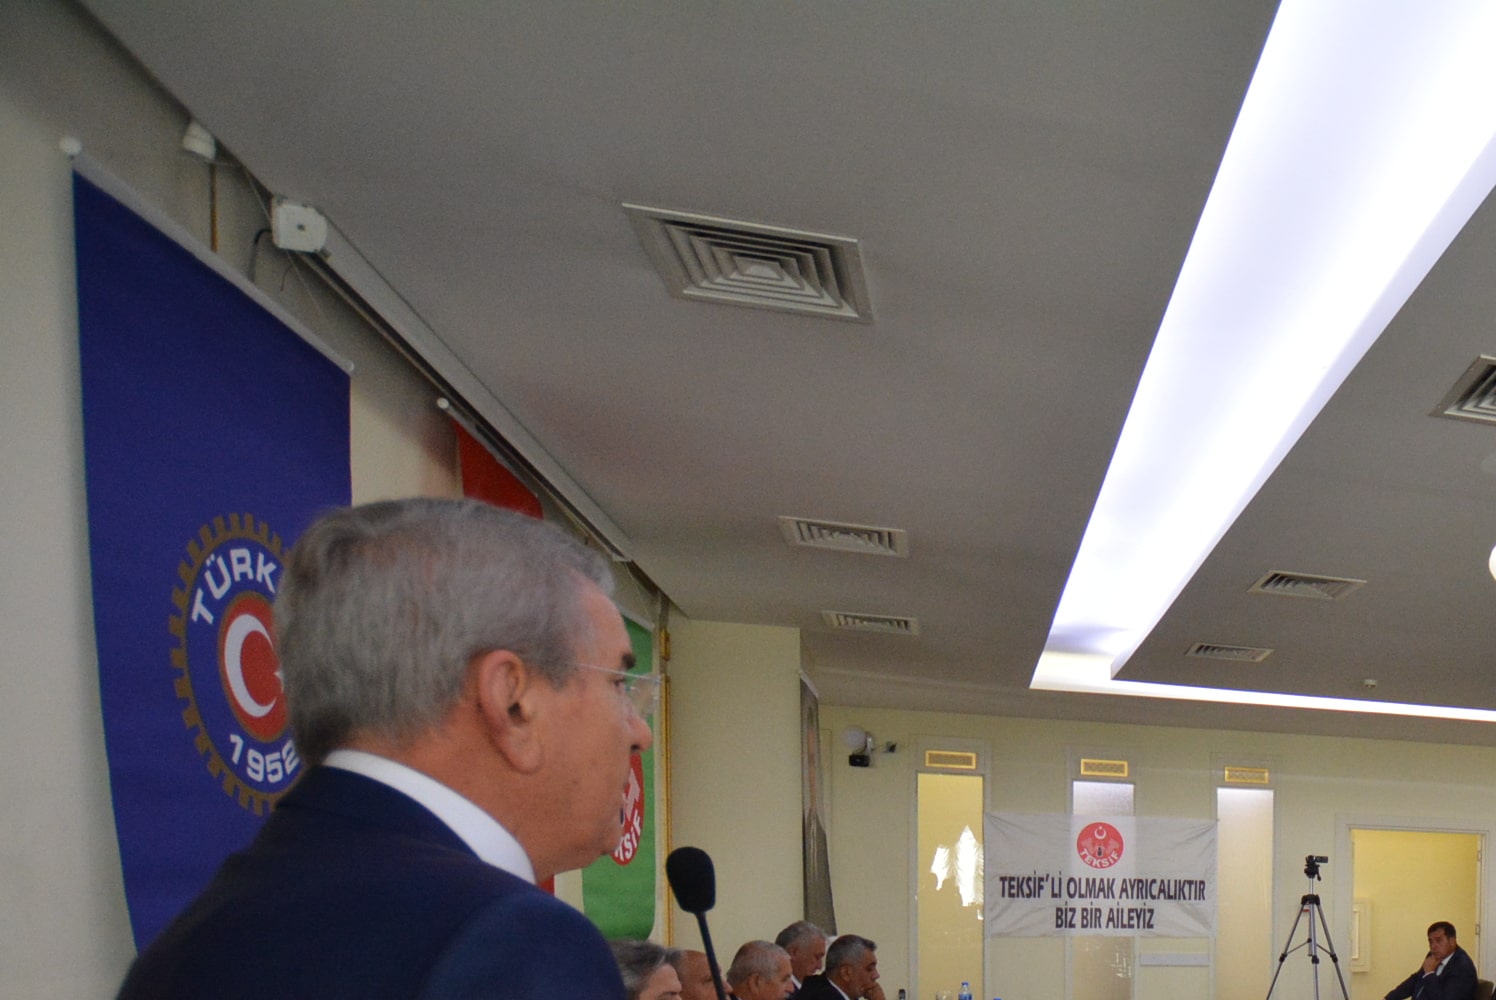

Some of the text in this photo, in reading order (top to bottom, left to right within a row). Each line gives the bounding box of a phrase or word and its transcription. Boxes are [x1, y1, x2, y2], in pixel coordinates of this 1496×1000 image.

[191, 547, 277, 625] TÜRK
[230, 733, 300, 784] 1952
[1067, 876, 1116, 900] OLMAK
[1119, 878, 1206, 901] AYRICALIKTIR
[1055, 901, 1155, 929] BİZ BİR AİLEYİZ
